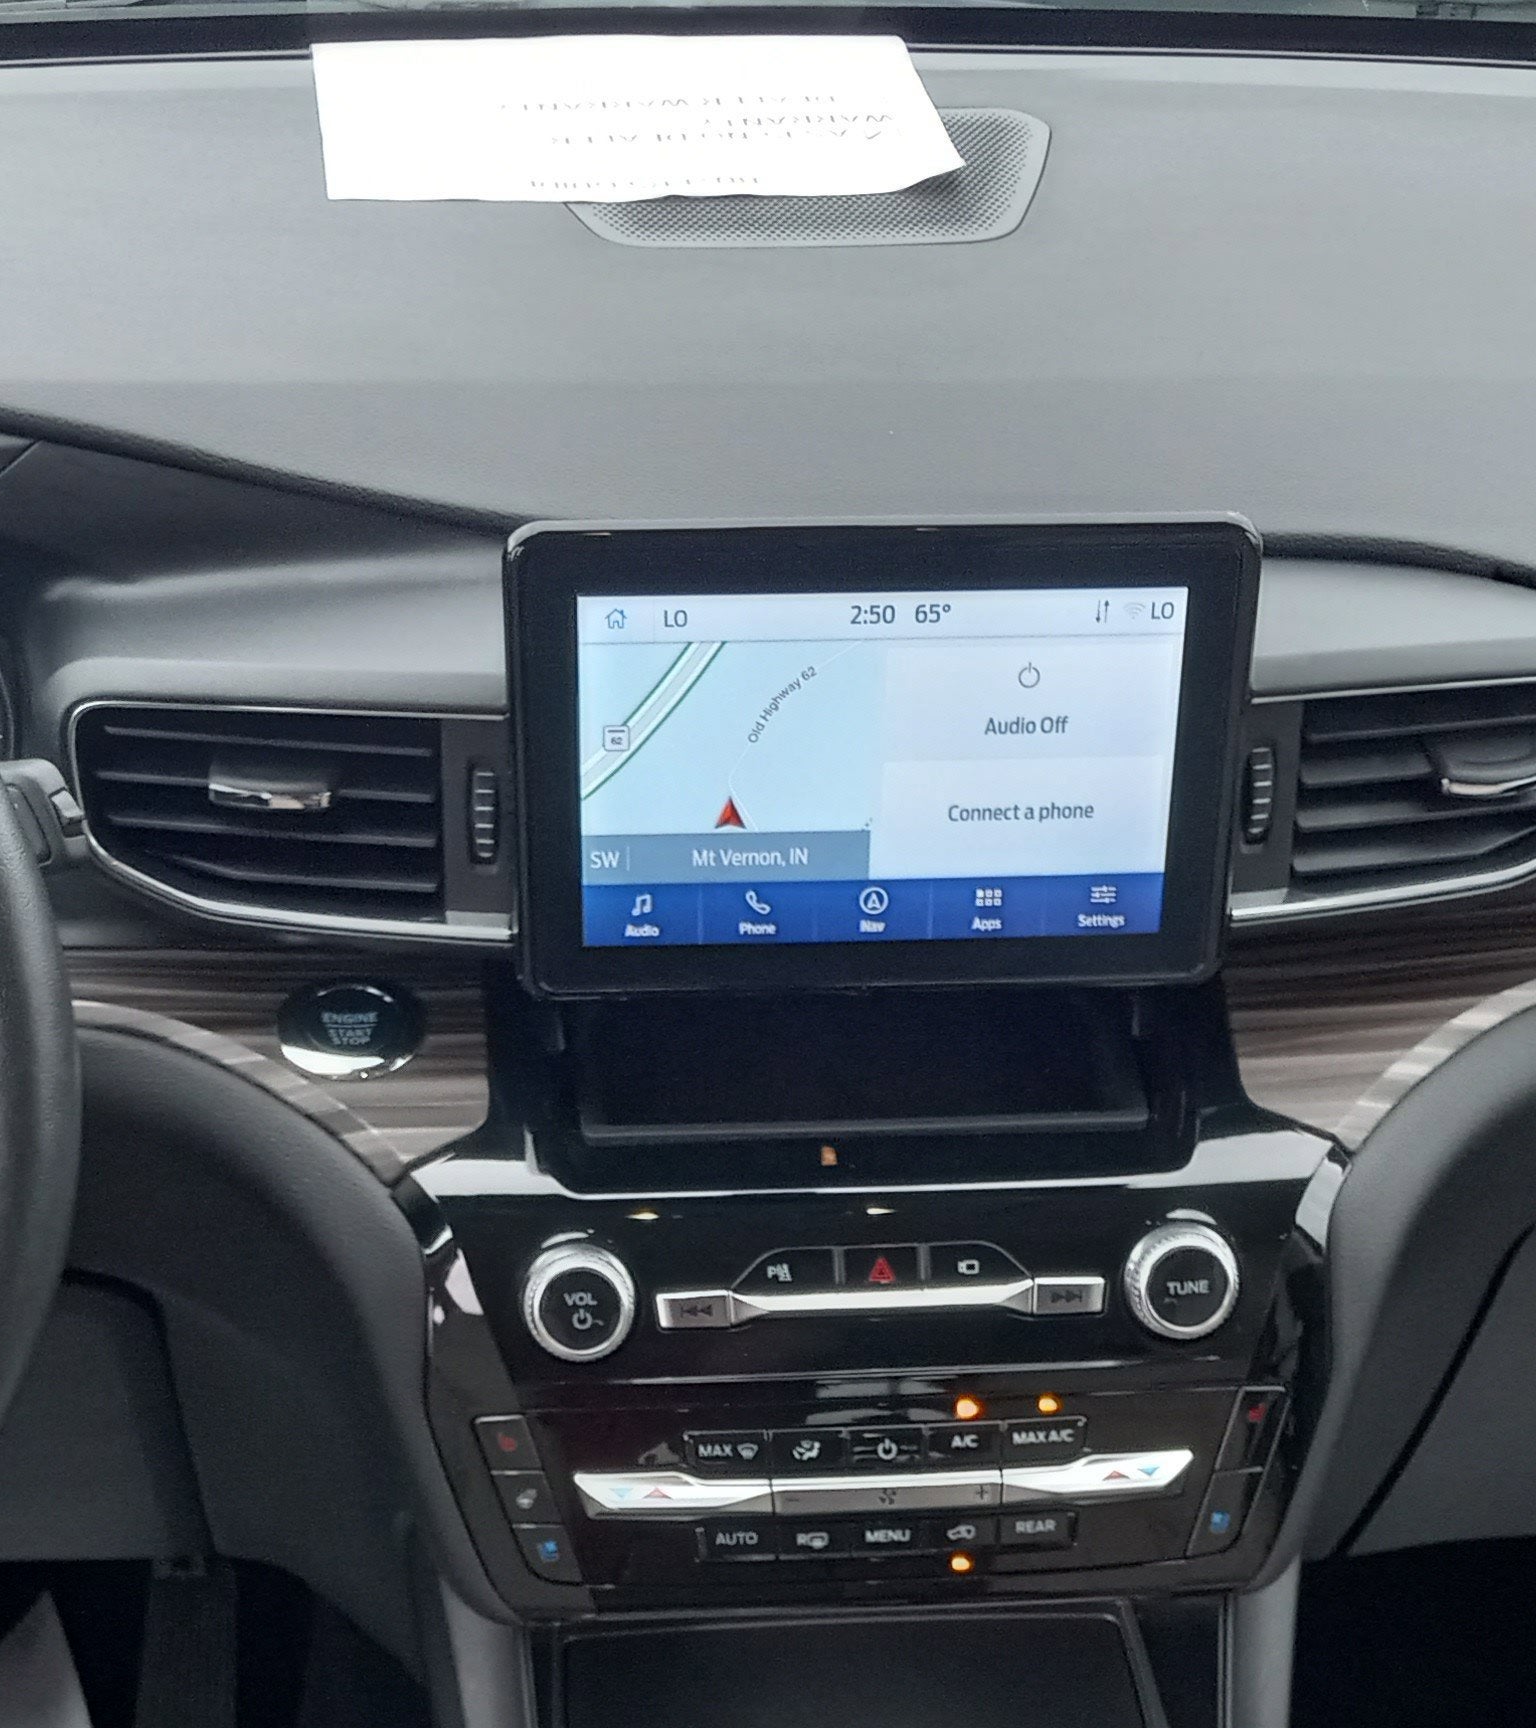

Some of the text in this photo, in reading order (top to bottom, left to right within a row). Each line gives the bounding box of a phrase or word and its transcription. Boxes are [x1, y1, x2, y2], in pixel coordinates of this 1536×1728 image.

[663, 609, 688, 629] LO
[849, 601, 953, 627] 2:50 65°
[1151, 601, 1174, 620] LO
[747, 666, 817, 743] Old Highway 62
[983, 715, 1069, 735] Audio Off
[610, 736, 623, 746] 62
[947, 801, 1095, 824] Connect a phone
[590, 850, 620, 870] SW
[691, 847, 809, 871] Mt Vernon, IN
[860, 919, 885, 934] Nav
[972, 915, 1002, 932] Apps
[1077, 911, 1126, 929] Settings
[625, 924, 659, 939] Audio
[738, 921, 776, 937] Phone
[320, 1011, 379, 1024] ENGINE
[327, 1027, 373, 1038] START
[330, 1036, 372, 1046] STOP
[1166, 1279, 1211, 1298] TUNE
[562, 1291, 598, 1307] VOL
[951, 1434, 979, 1449] A/C
[1011, 1428, 1075, 1445] MAX A/C
[698, 1443, 733, 1459] MAX
[1015, 1518, 1058, 1534] REAR
[715, 1531, 759, 1546] AUTO
[866, 1527, 911, 1544] MENU
